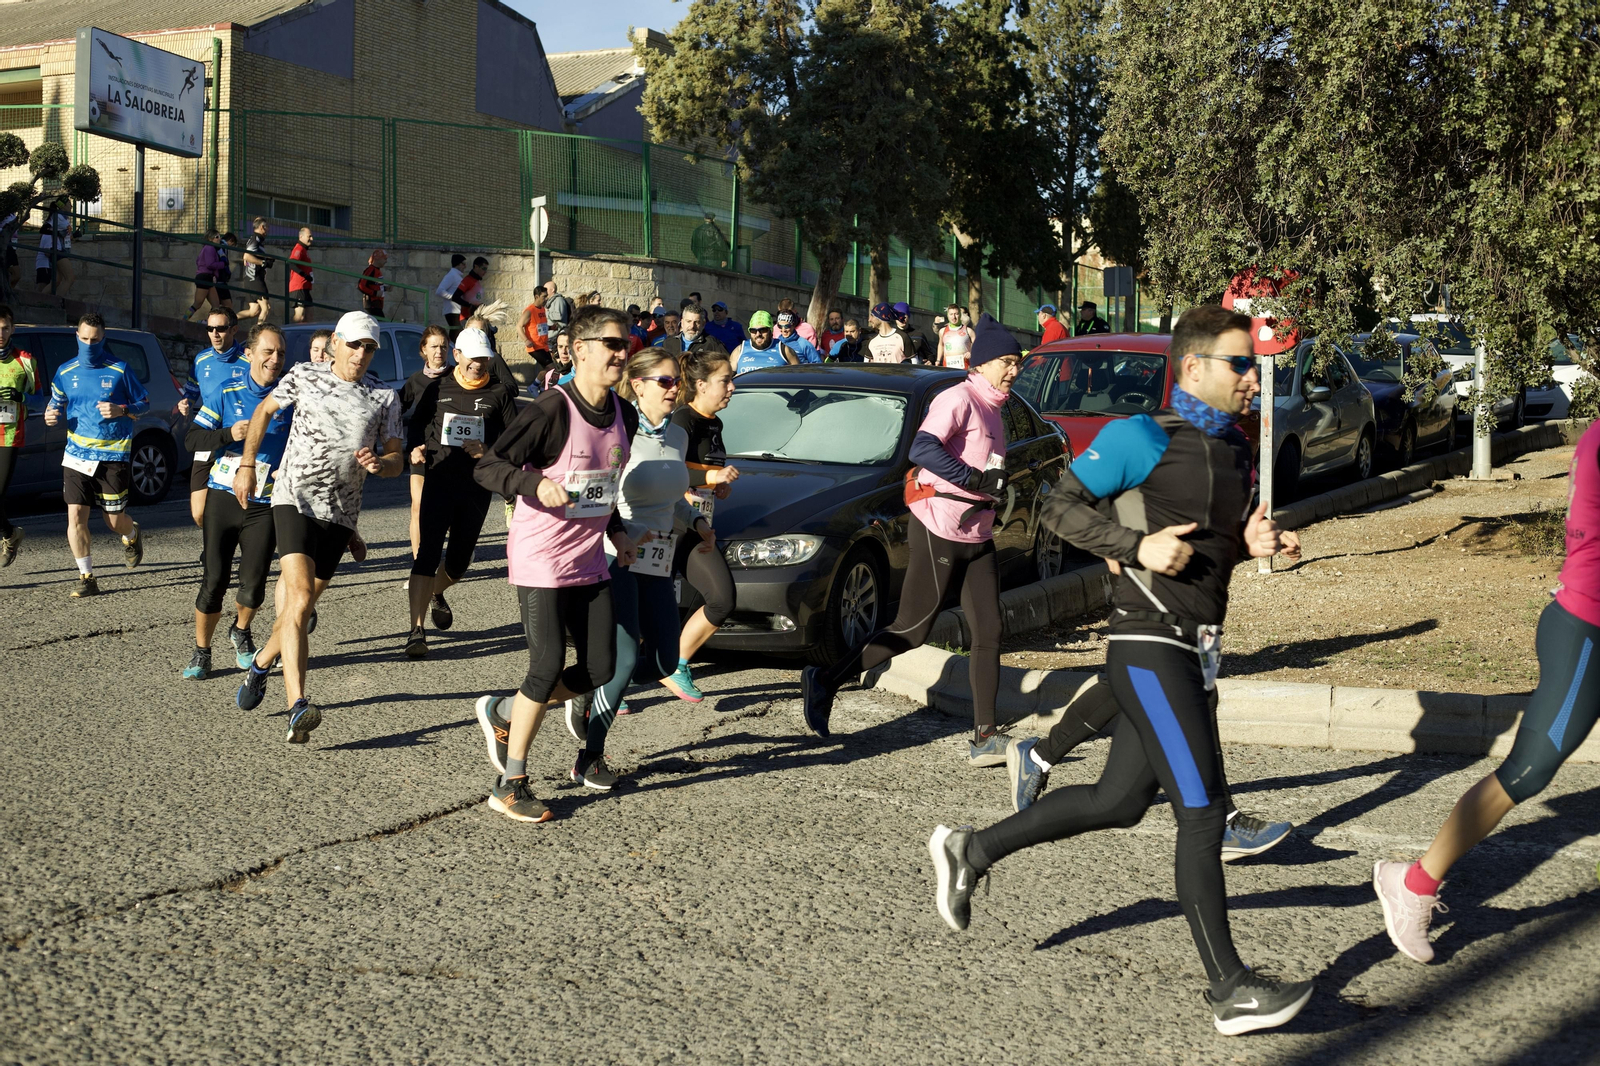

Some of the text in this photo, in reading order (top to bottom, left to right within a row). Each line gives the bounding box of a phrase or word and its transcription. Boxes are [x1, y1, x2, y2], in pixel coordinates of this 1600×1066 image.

[108, 75, 174, 99] INSTALACIONES DEPORTIVAS MUNICIPALES
[108, 84, 185, 123] LA SALOBREJA
[456, 425, 471, 436] 36
[586, 486, 603, 500] 88
[701, 500, 713, 513] 182
[651, 546, 665, 560] 78
